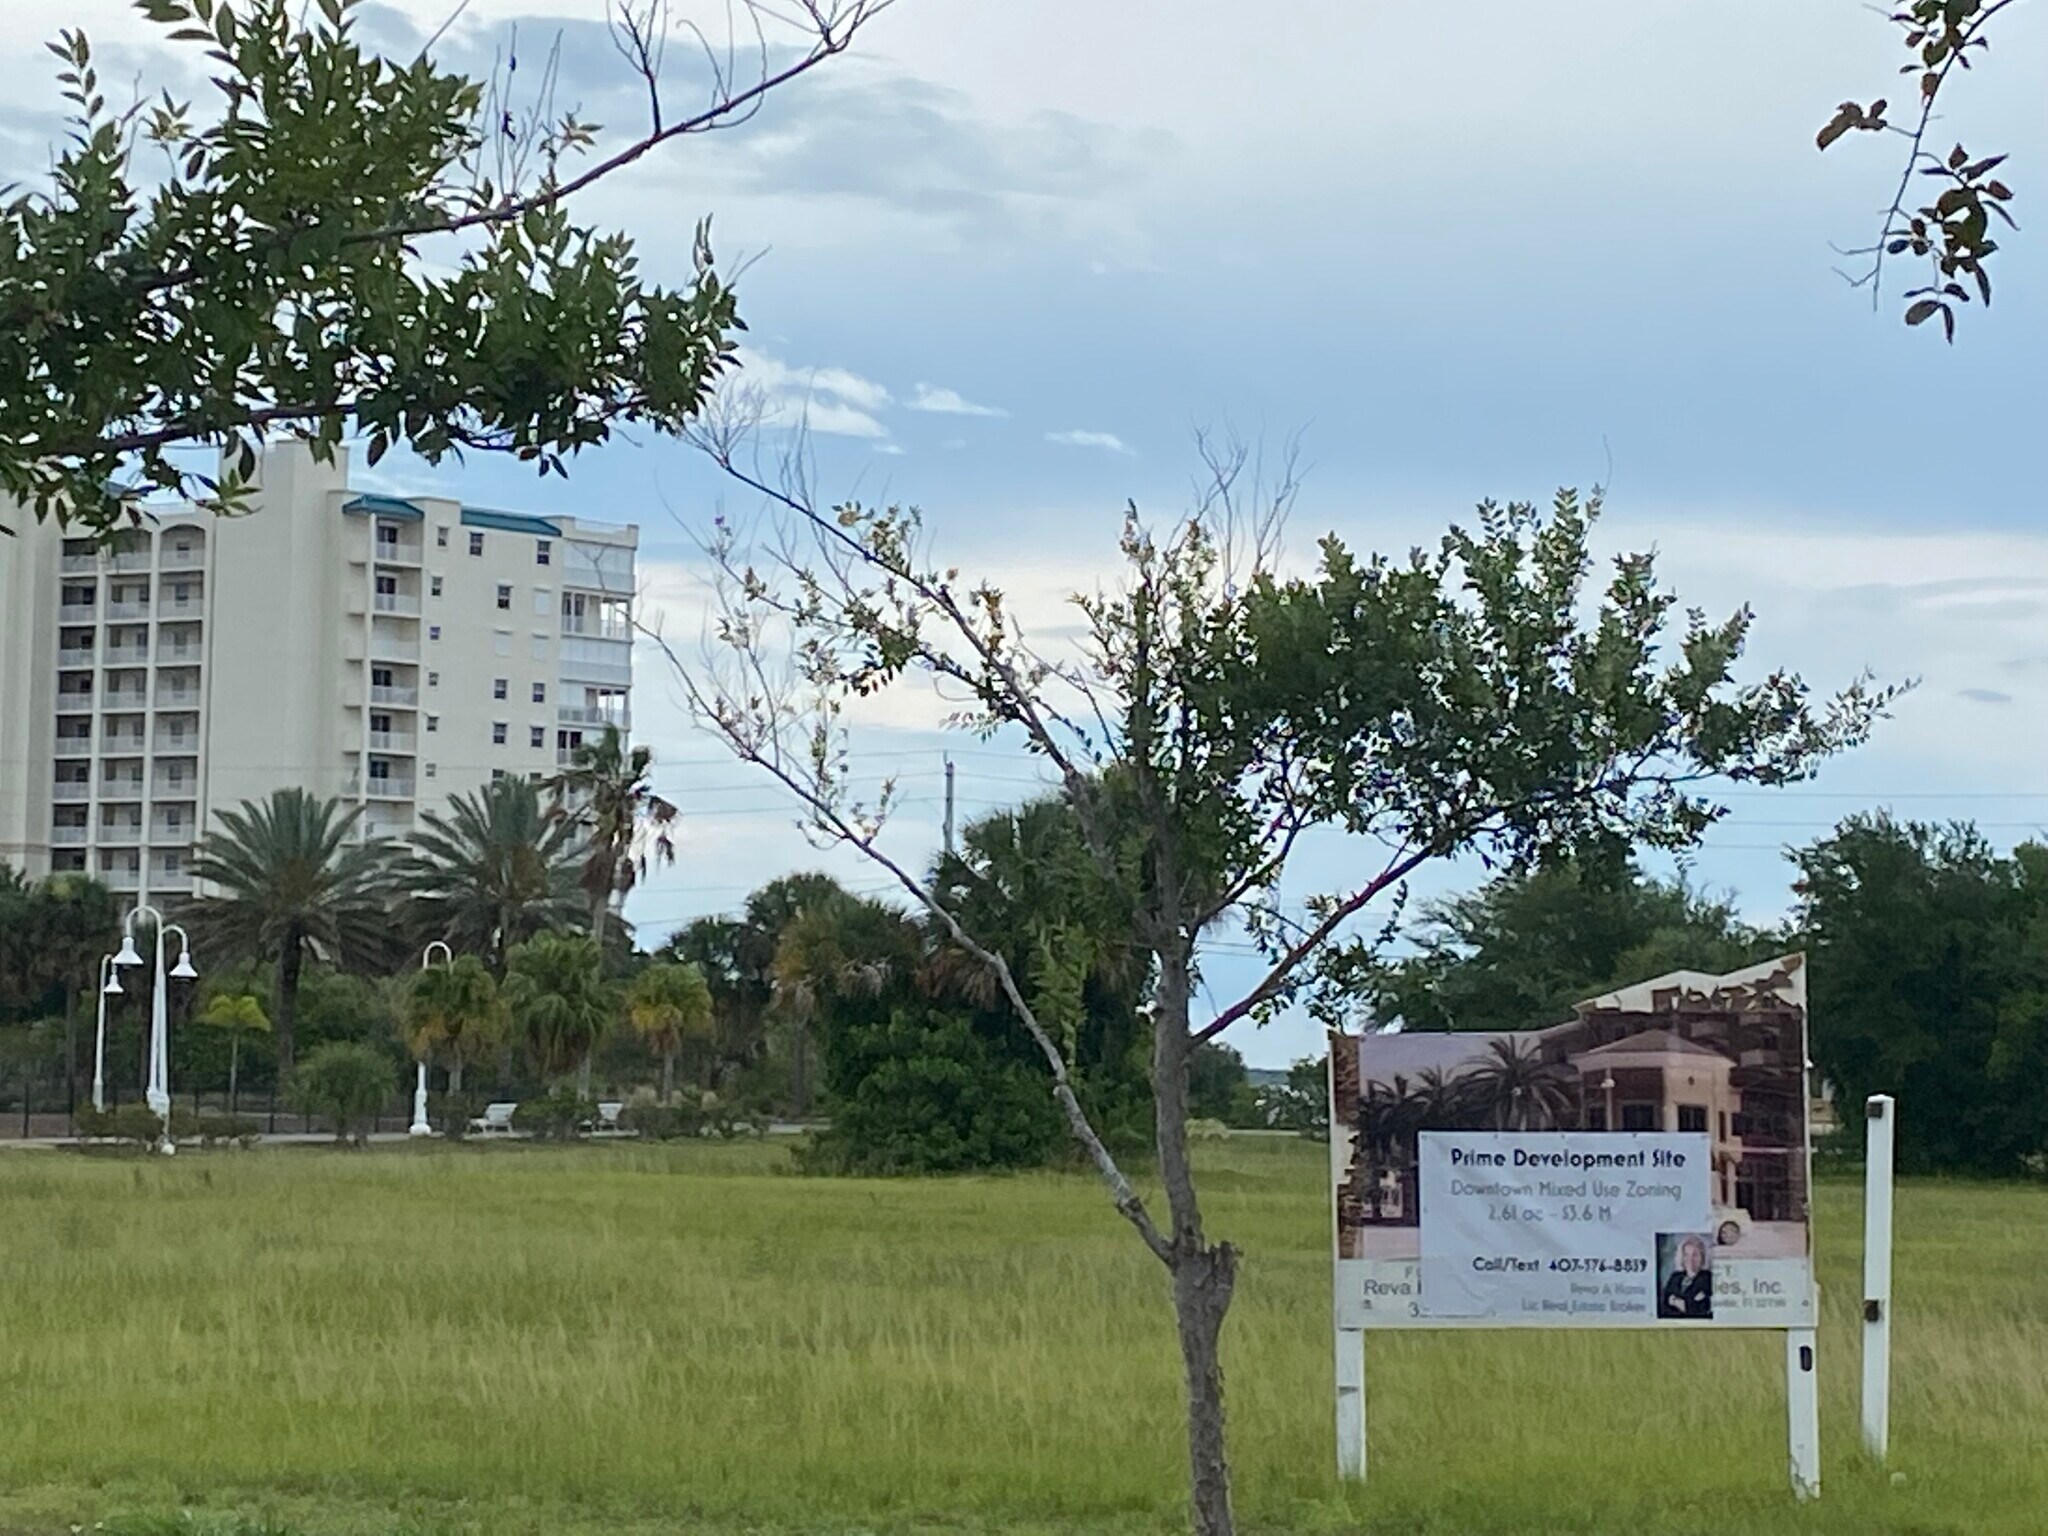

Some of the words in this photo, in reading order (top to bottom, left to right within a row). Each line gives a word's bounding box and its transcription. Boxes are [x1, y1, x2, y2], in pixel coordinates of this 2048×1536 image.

[1451, 1148, 1506, 1168] Prime
[1513, 1148, 1645, 1171] Development
[1652, 1148, 1686, 1168] Site
[1451, 1180, 1533, 1197] Downtown
[1538, 1180, 1586, 1197] Mixed
[1592, 1180, 1620, 1197] Use
[1625, 1180, 1682, 1201] Zoning
[1598, 1205, 1612, 1222] M
[1472, 1256, 1540, 1272] Call/Text
[1363, 1279, 1411, 1296] Reva
